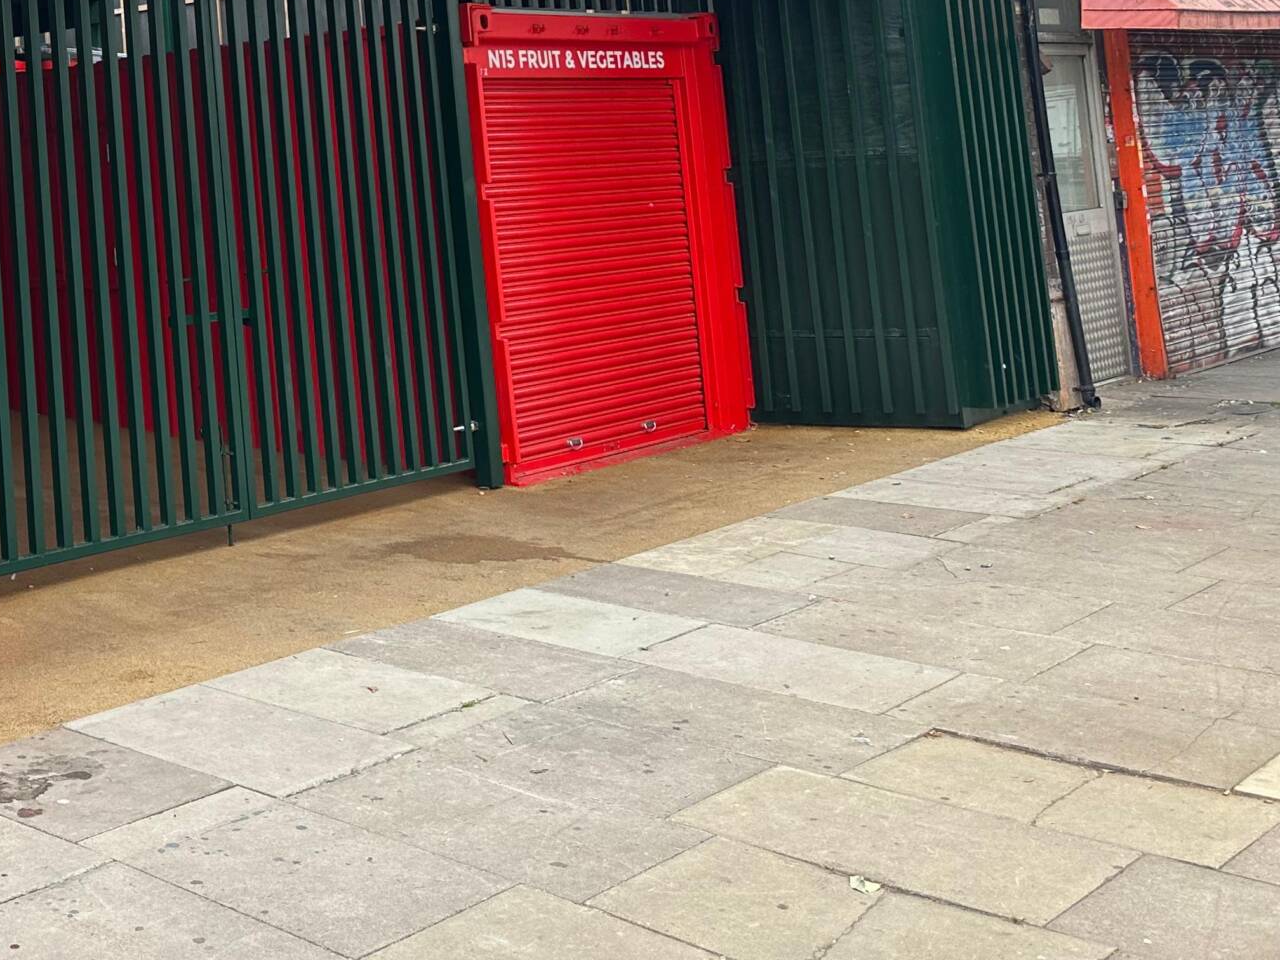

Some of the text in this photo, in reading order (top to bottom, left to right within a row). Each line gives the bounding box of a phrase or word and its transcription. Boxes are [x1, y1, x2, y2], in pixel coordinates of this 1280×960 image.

[487, 49, 665, 69] N15 FRUIT & VEGETABLES
